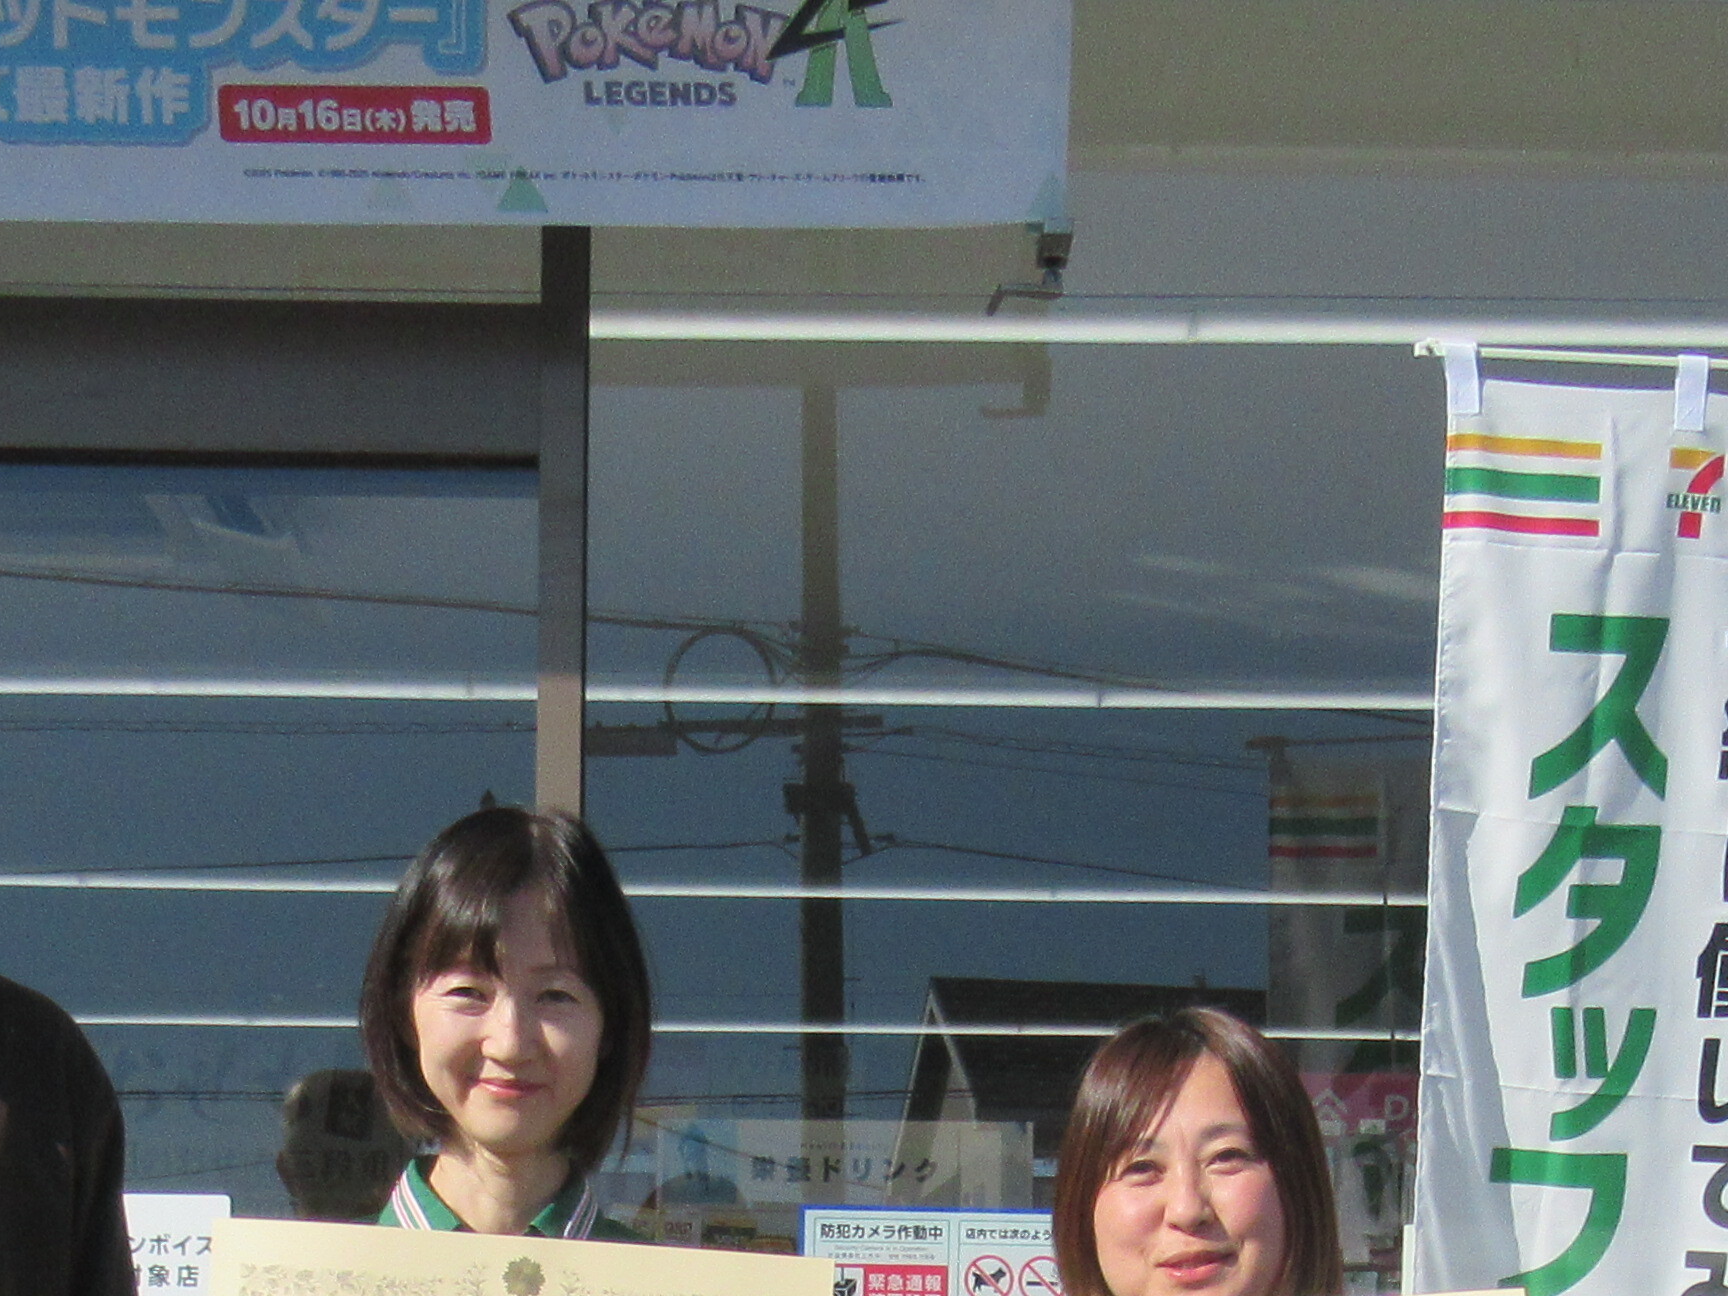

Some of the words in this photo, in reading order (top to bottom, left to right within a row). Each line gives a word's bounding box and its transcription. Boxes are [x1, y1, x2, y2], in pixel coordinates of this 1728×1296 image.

[584, 81, 739, 107] LEGENDS
[820, 1223, 943, 1241] 防犯カメラ作動中
[868, 1273, 942, 1292] 緊急通報
